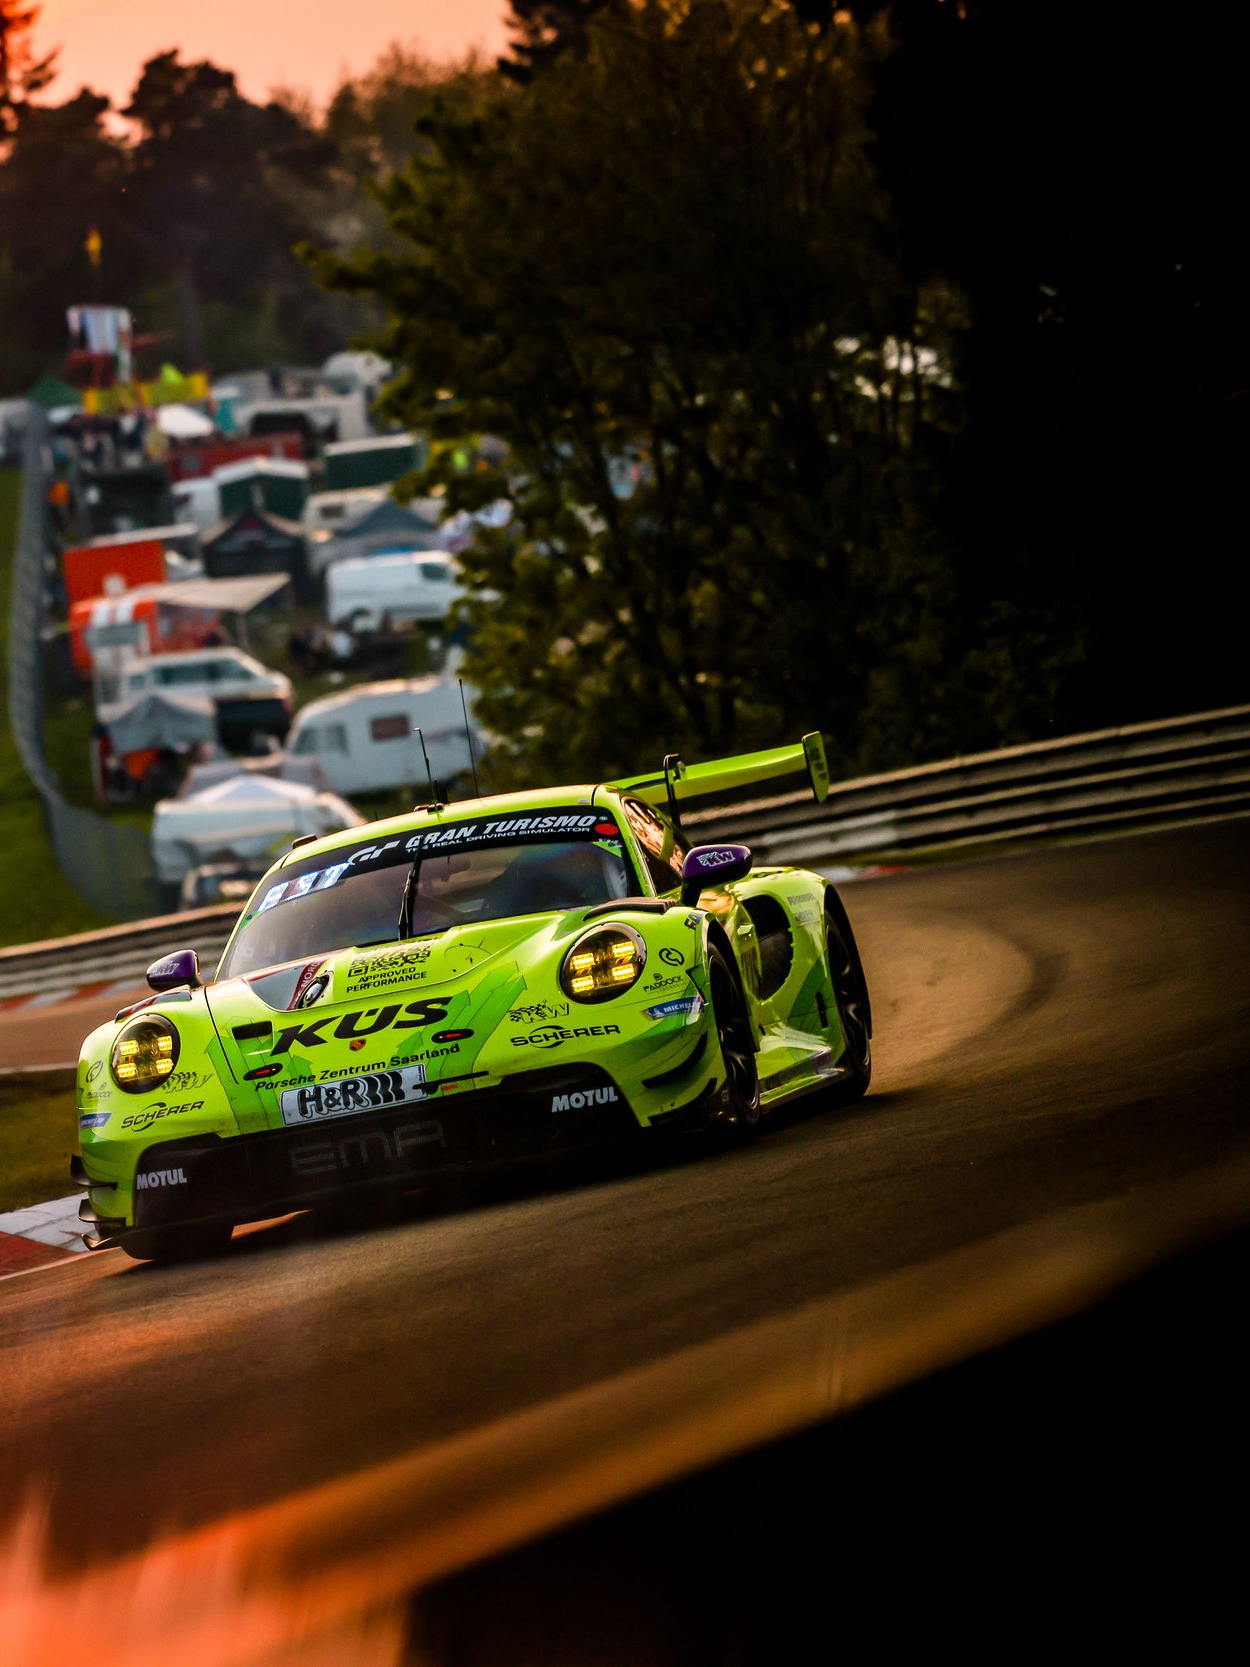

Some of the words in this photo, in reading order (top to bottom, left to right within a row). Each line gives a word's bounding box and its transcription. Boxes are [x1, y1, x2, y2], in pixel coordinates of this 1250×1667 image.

[405, 825, 477, 848] GRAN
[432, 838, 463, 848] REAL
[466, 831, 510, 842] DRIVING
[512, 827, 591, 838] SIMULATOR
[346, 972, 427, 993] PERFORMANCE
[358, 966, 417, 982] APPROVED
[643, 975, 684, 992] PADDOCK
[514, 1002, 570, 1024] KW
[270, 997, 454, 1056] KÜS
[510, 1024, 621, 1047] SCHERER
[255, 1073, 316, 1091] Porsche
[320, 1060, 387, 1079] Zentrum
[390, 1043, 461, 1067] Saarland
[551, 1086, 619, 1113] MOTUL
[121, 1101, 205, 1130] SCHERER
[136, 1168, 188, 1190] MOTUL
